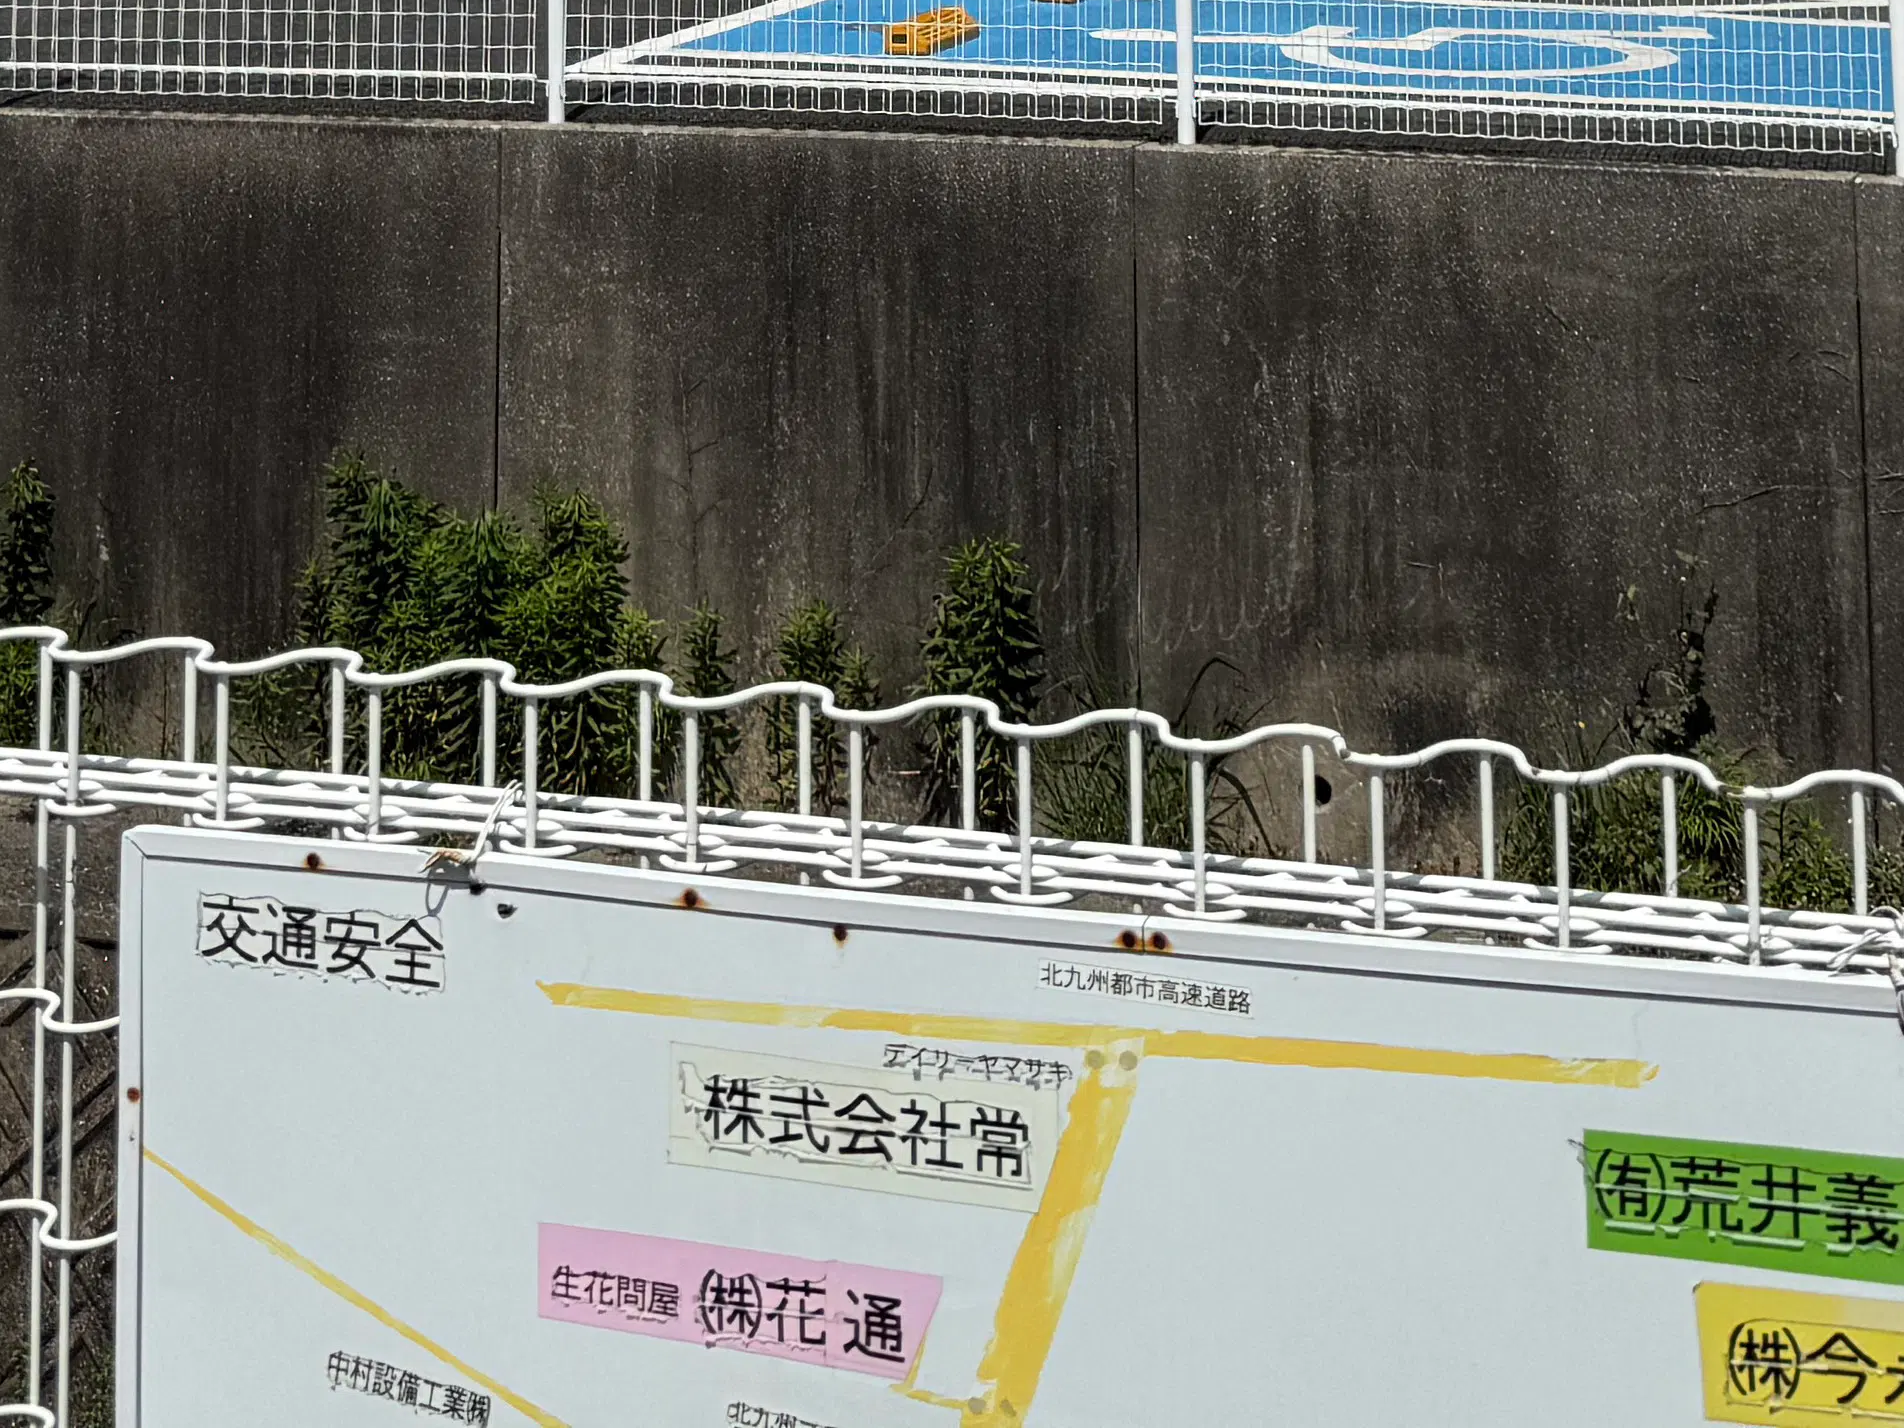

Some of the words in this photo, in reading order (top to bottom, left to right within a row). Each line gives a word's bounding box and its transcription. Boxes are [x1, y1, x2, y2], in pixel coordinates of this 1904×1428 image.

[201, 895, 444, 988] 交通安全
[1040, 962, 1251, 1015] 北九州都市高速道路
[703, 1074, 1030, 1178] 株式会社常
[551, 1265, 680, 1318] 生花問屋
